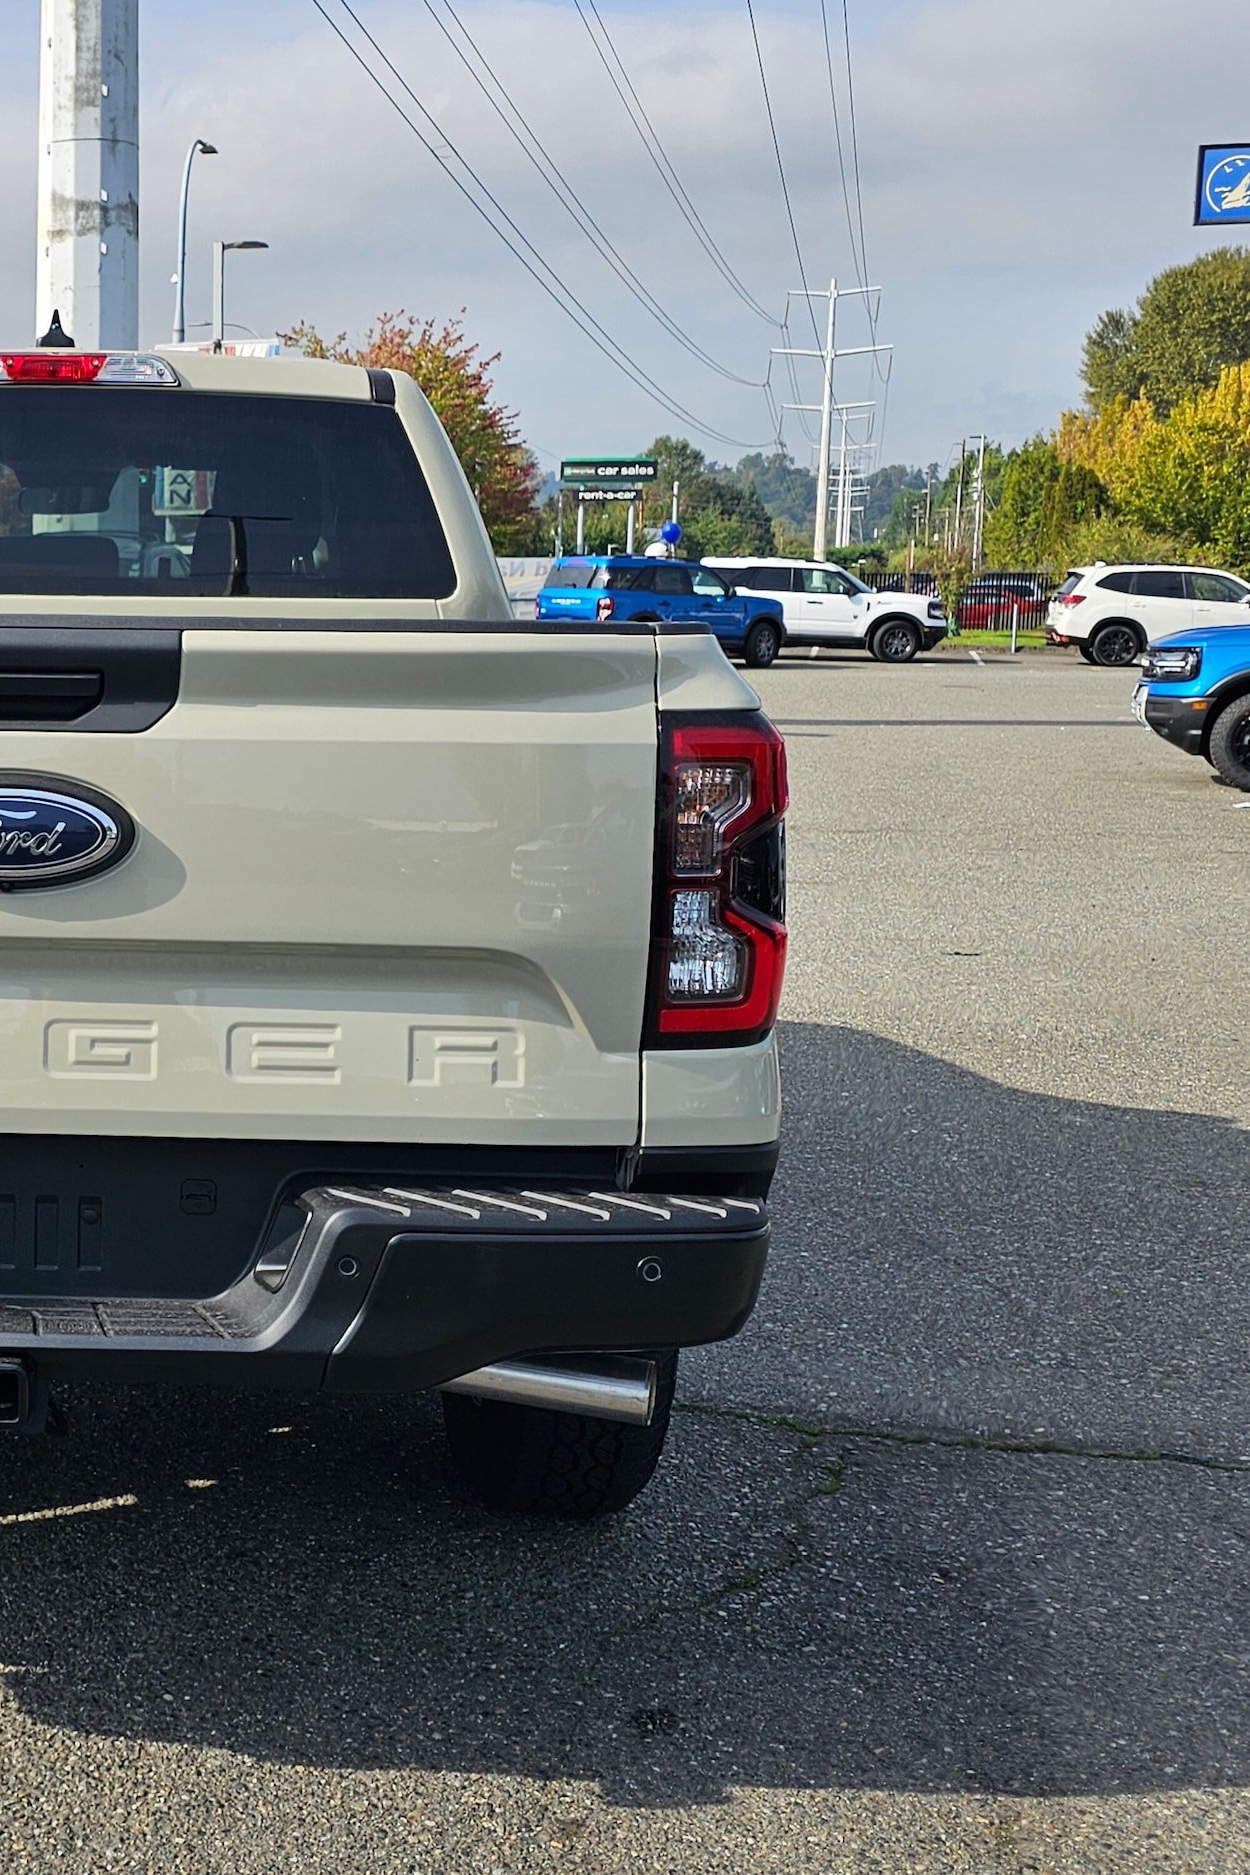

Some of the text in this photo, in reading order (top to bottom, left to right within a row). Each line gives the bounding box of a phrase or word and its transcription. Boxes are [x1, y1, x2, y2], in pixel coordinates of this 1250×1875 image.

[597, 466, 619, 476] car
[620, 464, 654, 476] sales
[578, 490, 637, 500] rent-a-car
